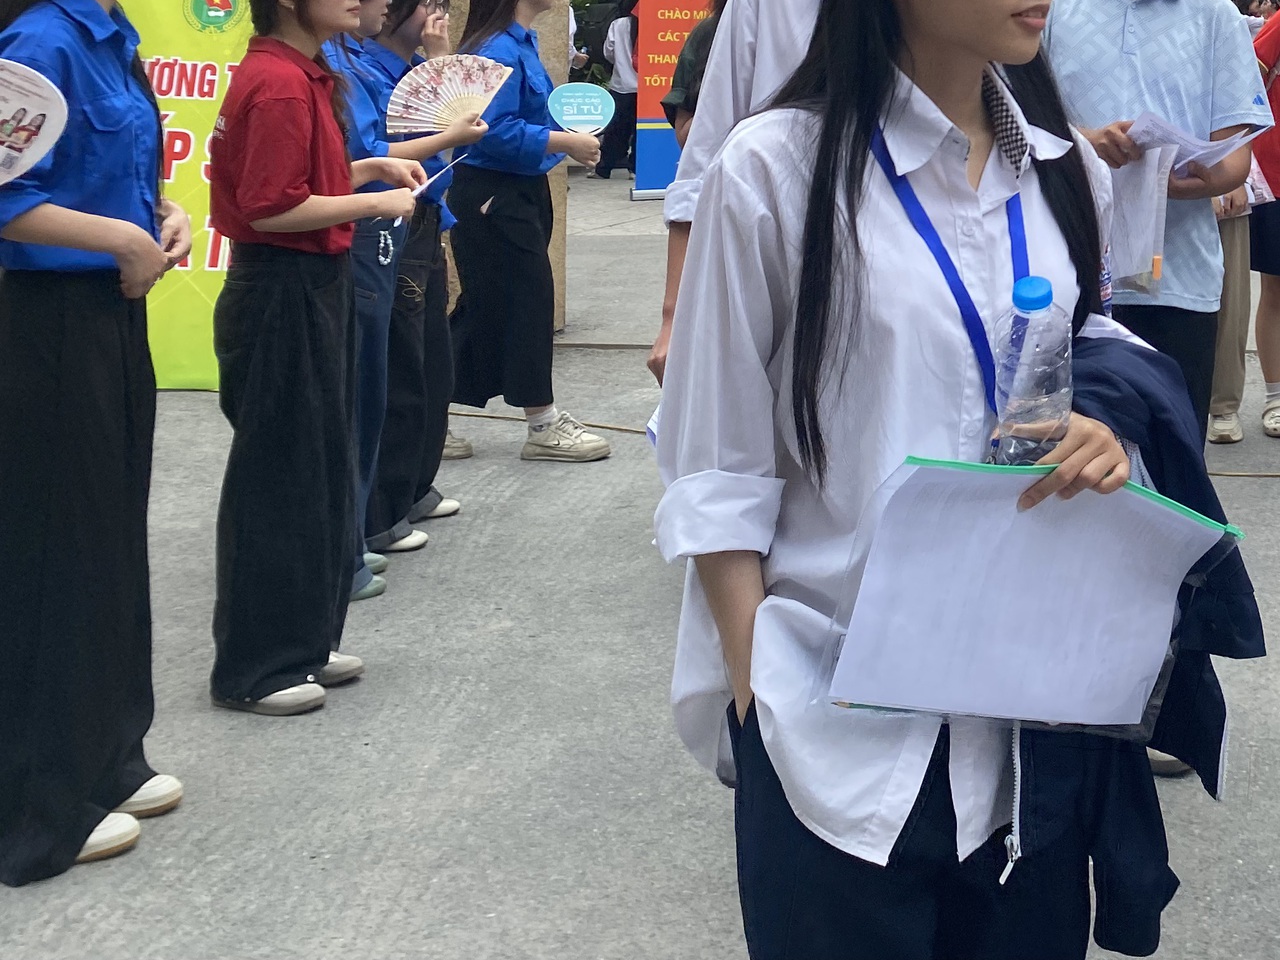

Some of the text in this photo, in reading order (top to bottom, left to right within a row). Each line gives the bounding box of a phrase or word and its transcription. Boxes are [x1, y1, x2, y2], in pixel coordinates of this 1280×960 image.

[657, 7, 690, 20] CHÀO
[657, 30, 680, 42] CÁC
[644, 74, 667, 86] TỐT
